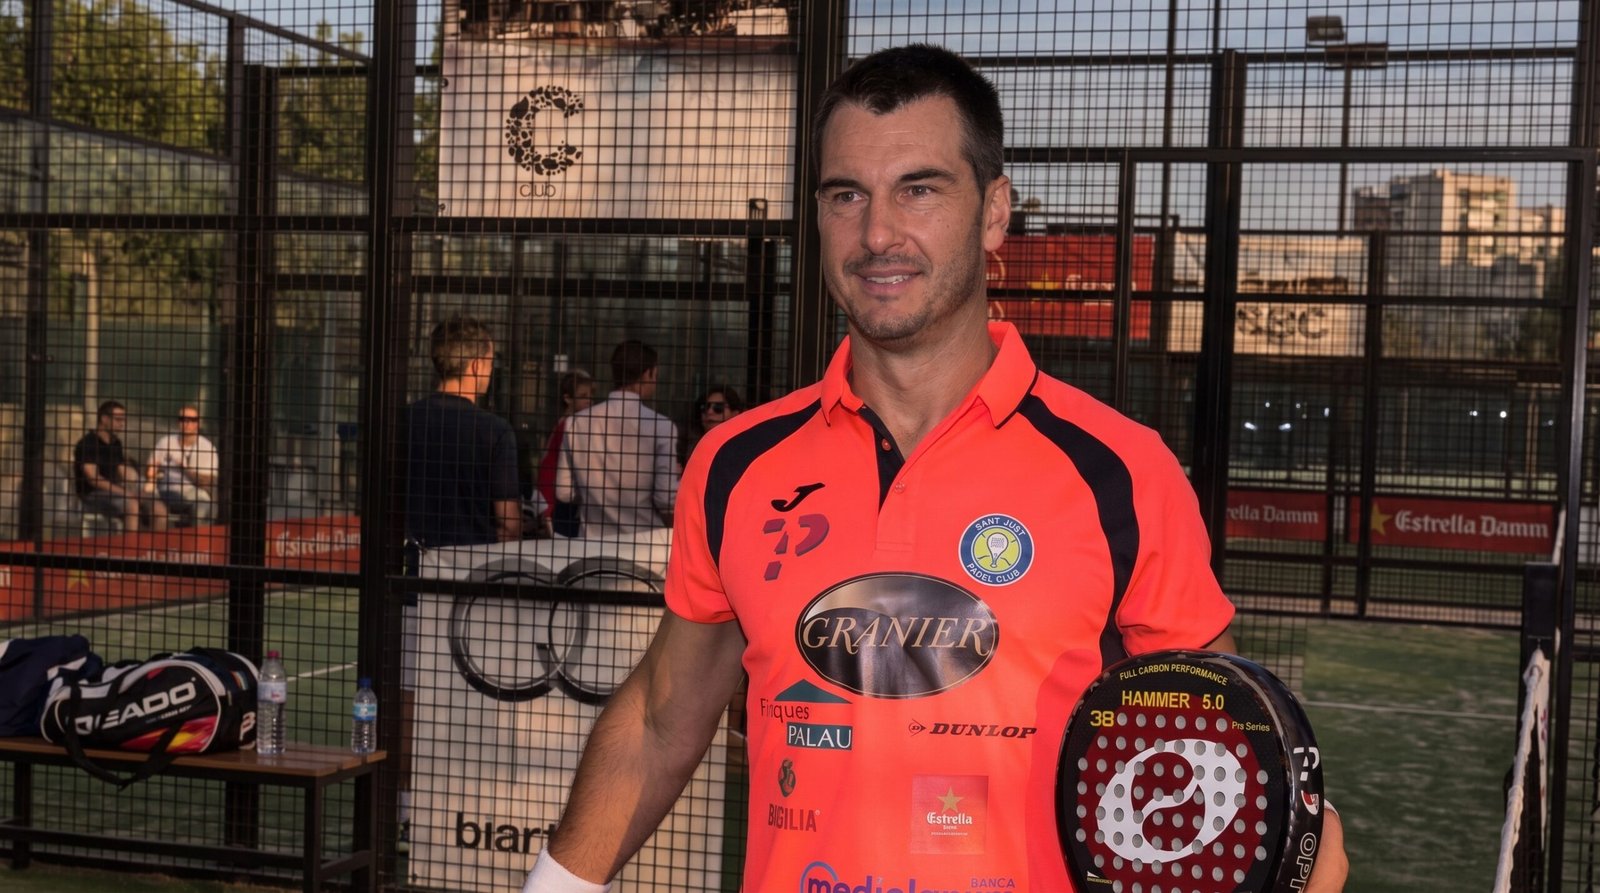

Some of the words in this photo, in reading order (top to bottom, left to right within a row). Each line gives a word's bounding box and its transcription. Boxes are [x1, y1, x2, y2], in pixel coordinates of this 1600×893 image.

[519, 180, 556, 197] club
[1226, 505, 1260, 521] rella
[1263, 505, 1318, 523] Damm
[1395, 509, 1476, 534] Estrella
[1480, 515, 1549, 538] Damm
[975, 517, 1001, 531] SANT
[1003, 519, 1026, 537] JUST
[966, 563, 993, 583] PADEL
[995, 569, 1021, 583] CLUB
[802, 616, 991, 657] GRANIER
[1119, 669, 1138, 681] FULL
[1138, 663, 1170, 676] CARBON
[1171, 663, 1229, 687] PERFORMANCE
[760, 698, 810, 723] Finques
[1121, 690, 1190, 709] HAMMER
[1202, 693, 1225, 711] 5.0
[1090, 710, 1114, 728] 38
[1246, 722, 1270, 733] Series
[788, 725, 852, 749] PALAU
[929, 722, 1038, 739] DUNLOP
[926, 811, 973, 825] Estrella
[970, 878, 1016, 889] BANCA
